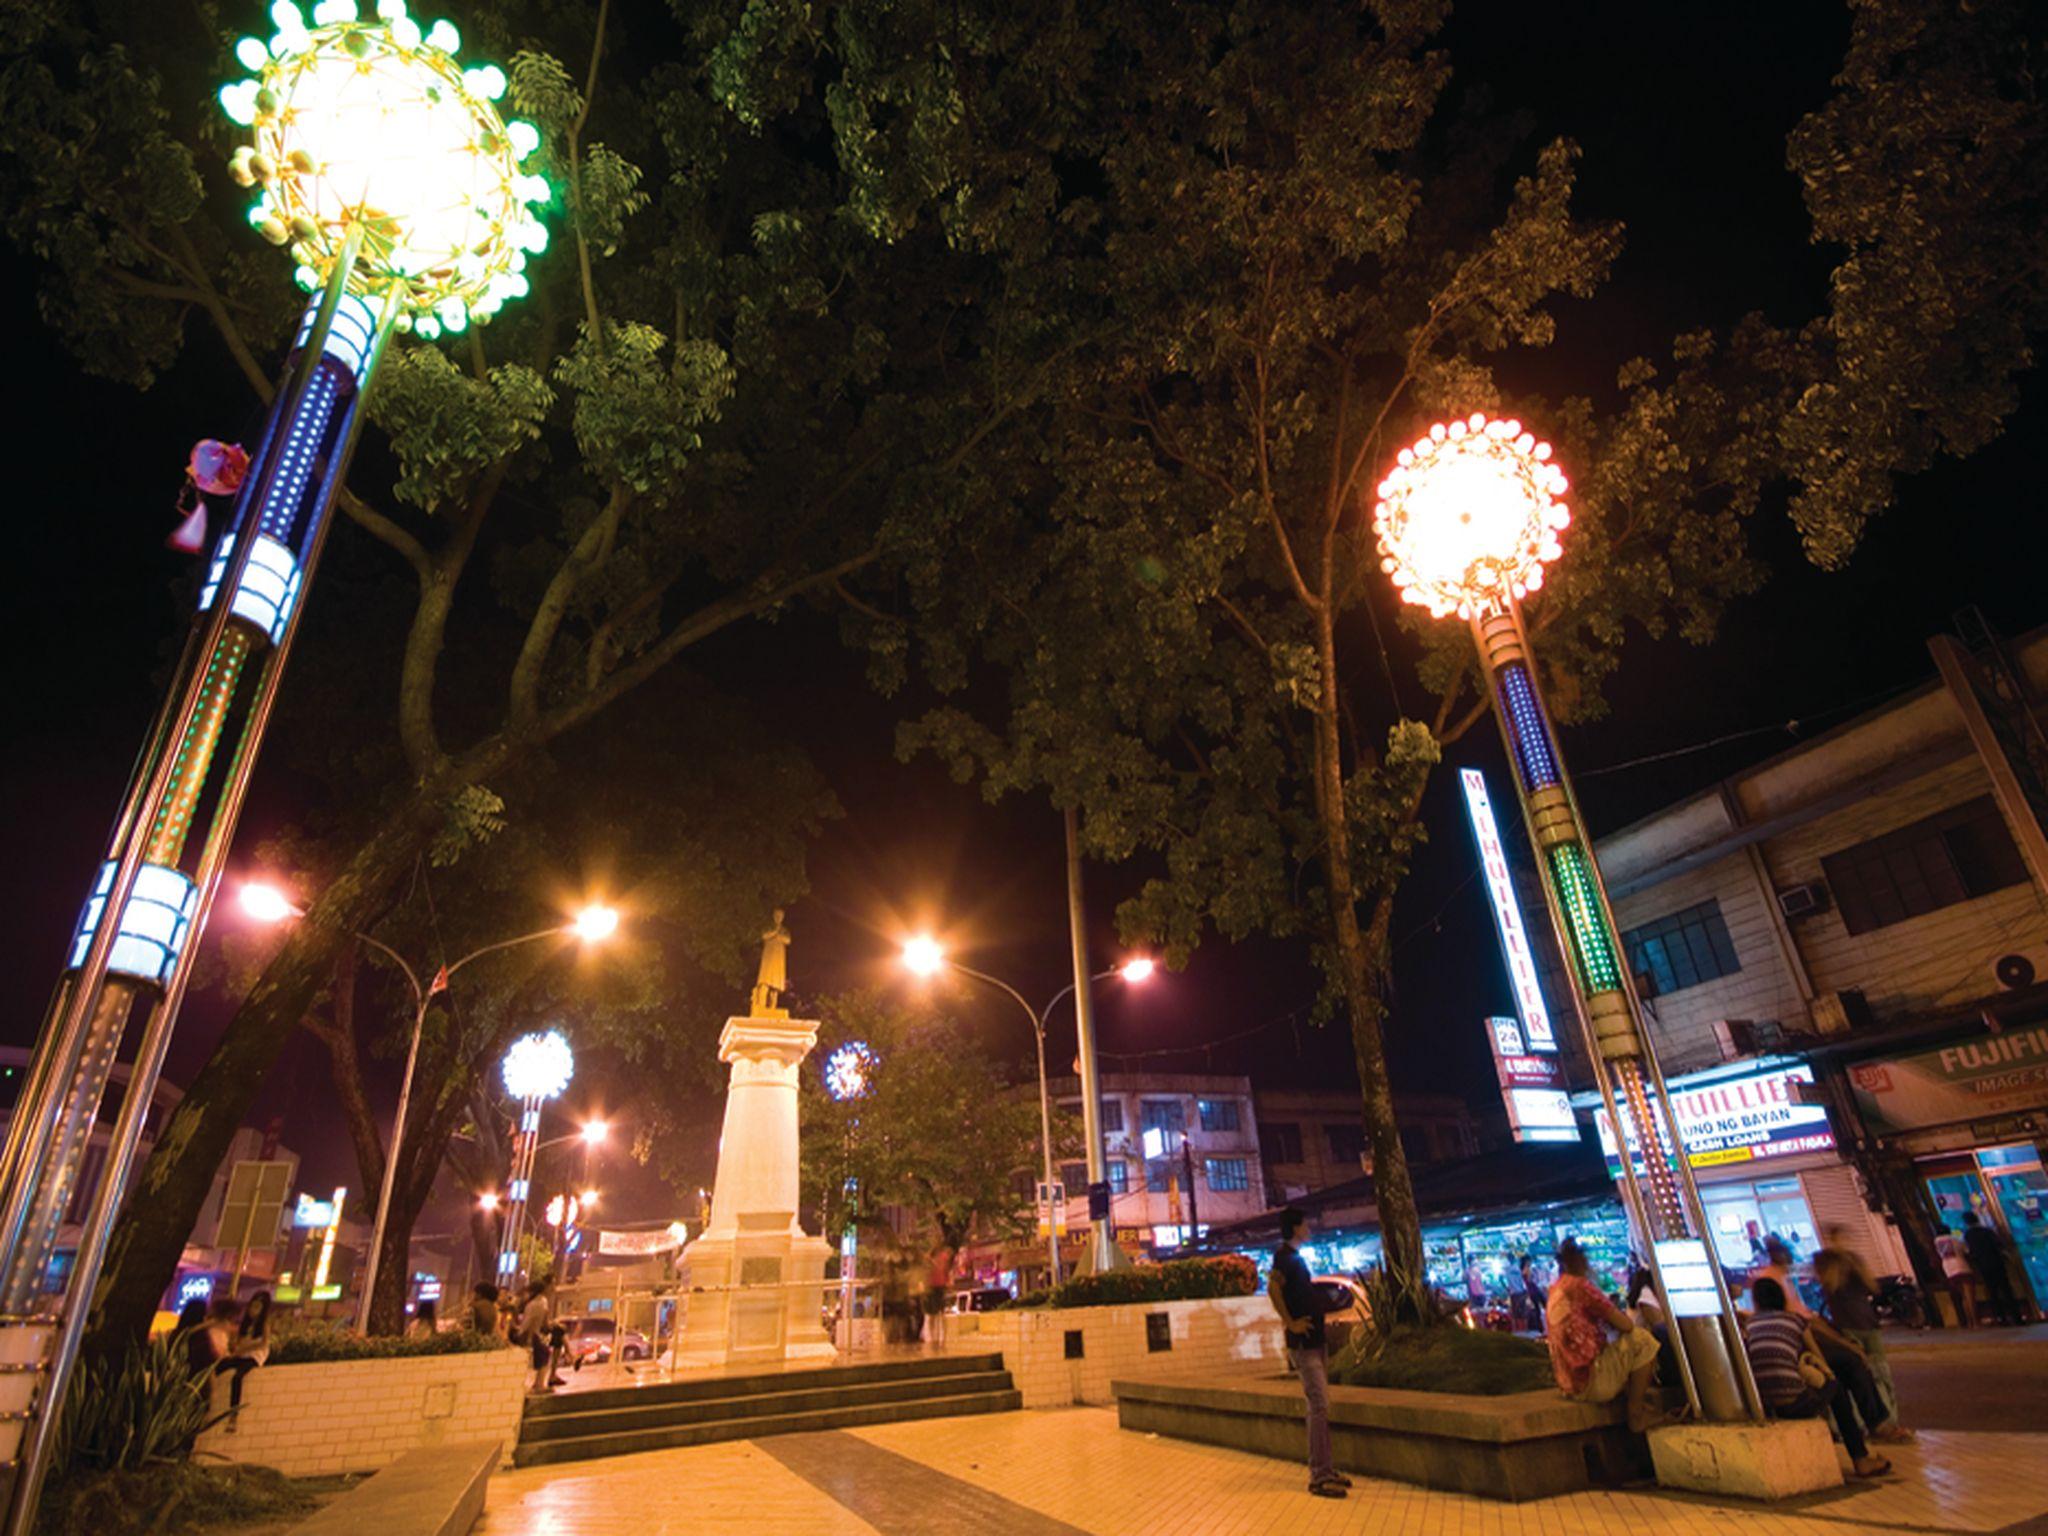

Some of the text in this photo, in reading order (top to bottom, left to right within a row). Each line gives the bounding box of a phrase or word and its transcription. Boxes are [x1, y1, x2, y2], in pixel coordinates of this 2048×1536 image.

[1500, 1031, 1518, 1043] 24
[1975, 1066, 2048, 1094] IMAGE S
[1716, 1118, 1738, 1132] NG
[1741, 1108, 1791, 1127] BAYAN
